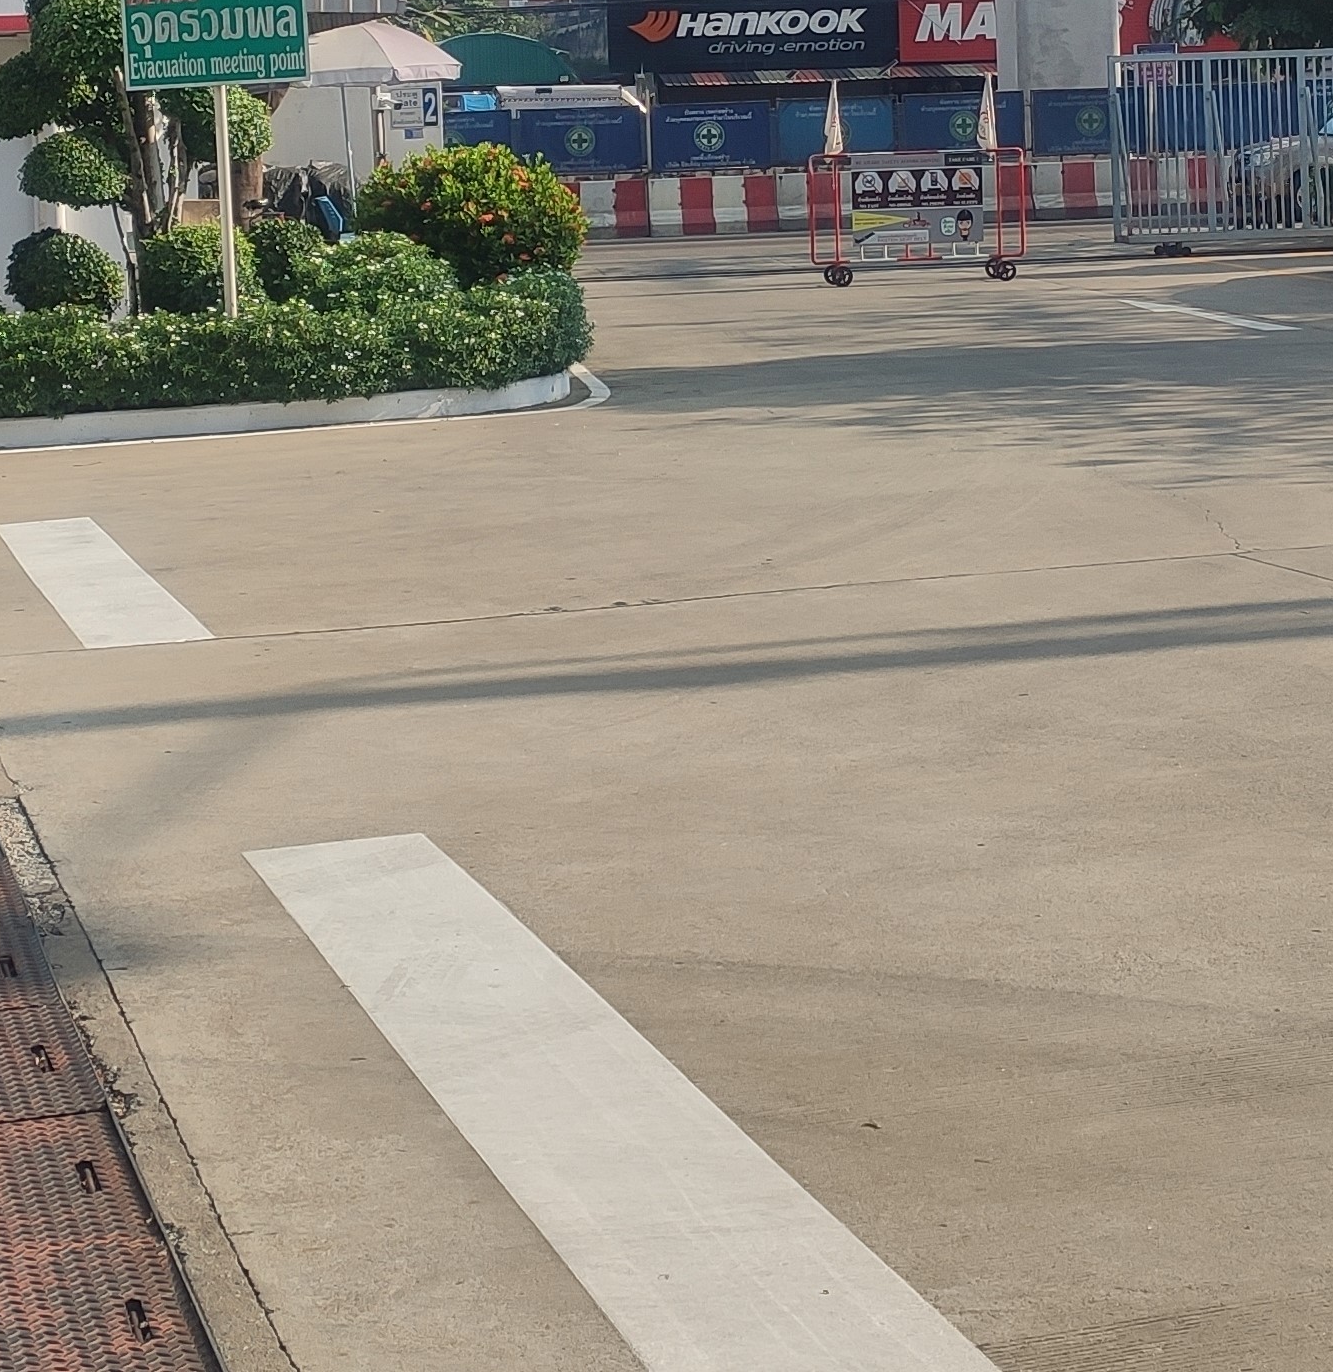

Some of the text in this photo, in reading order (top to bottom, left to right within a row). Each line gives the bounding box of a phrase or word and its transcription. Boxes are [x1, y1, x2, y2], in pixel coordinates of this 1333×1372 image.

[130, 5, 298, 59] จุดรวมพล
[708, 40, 775, 55] driving
[129, 46, 306, 80] Evacuation meeting point
[424, 92, 437, 123] 2
